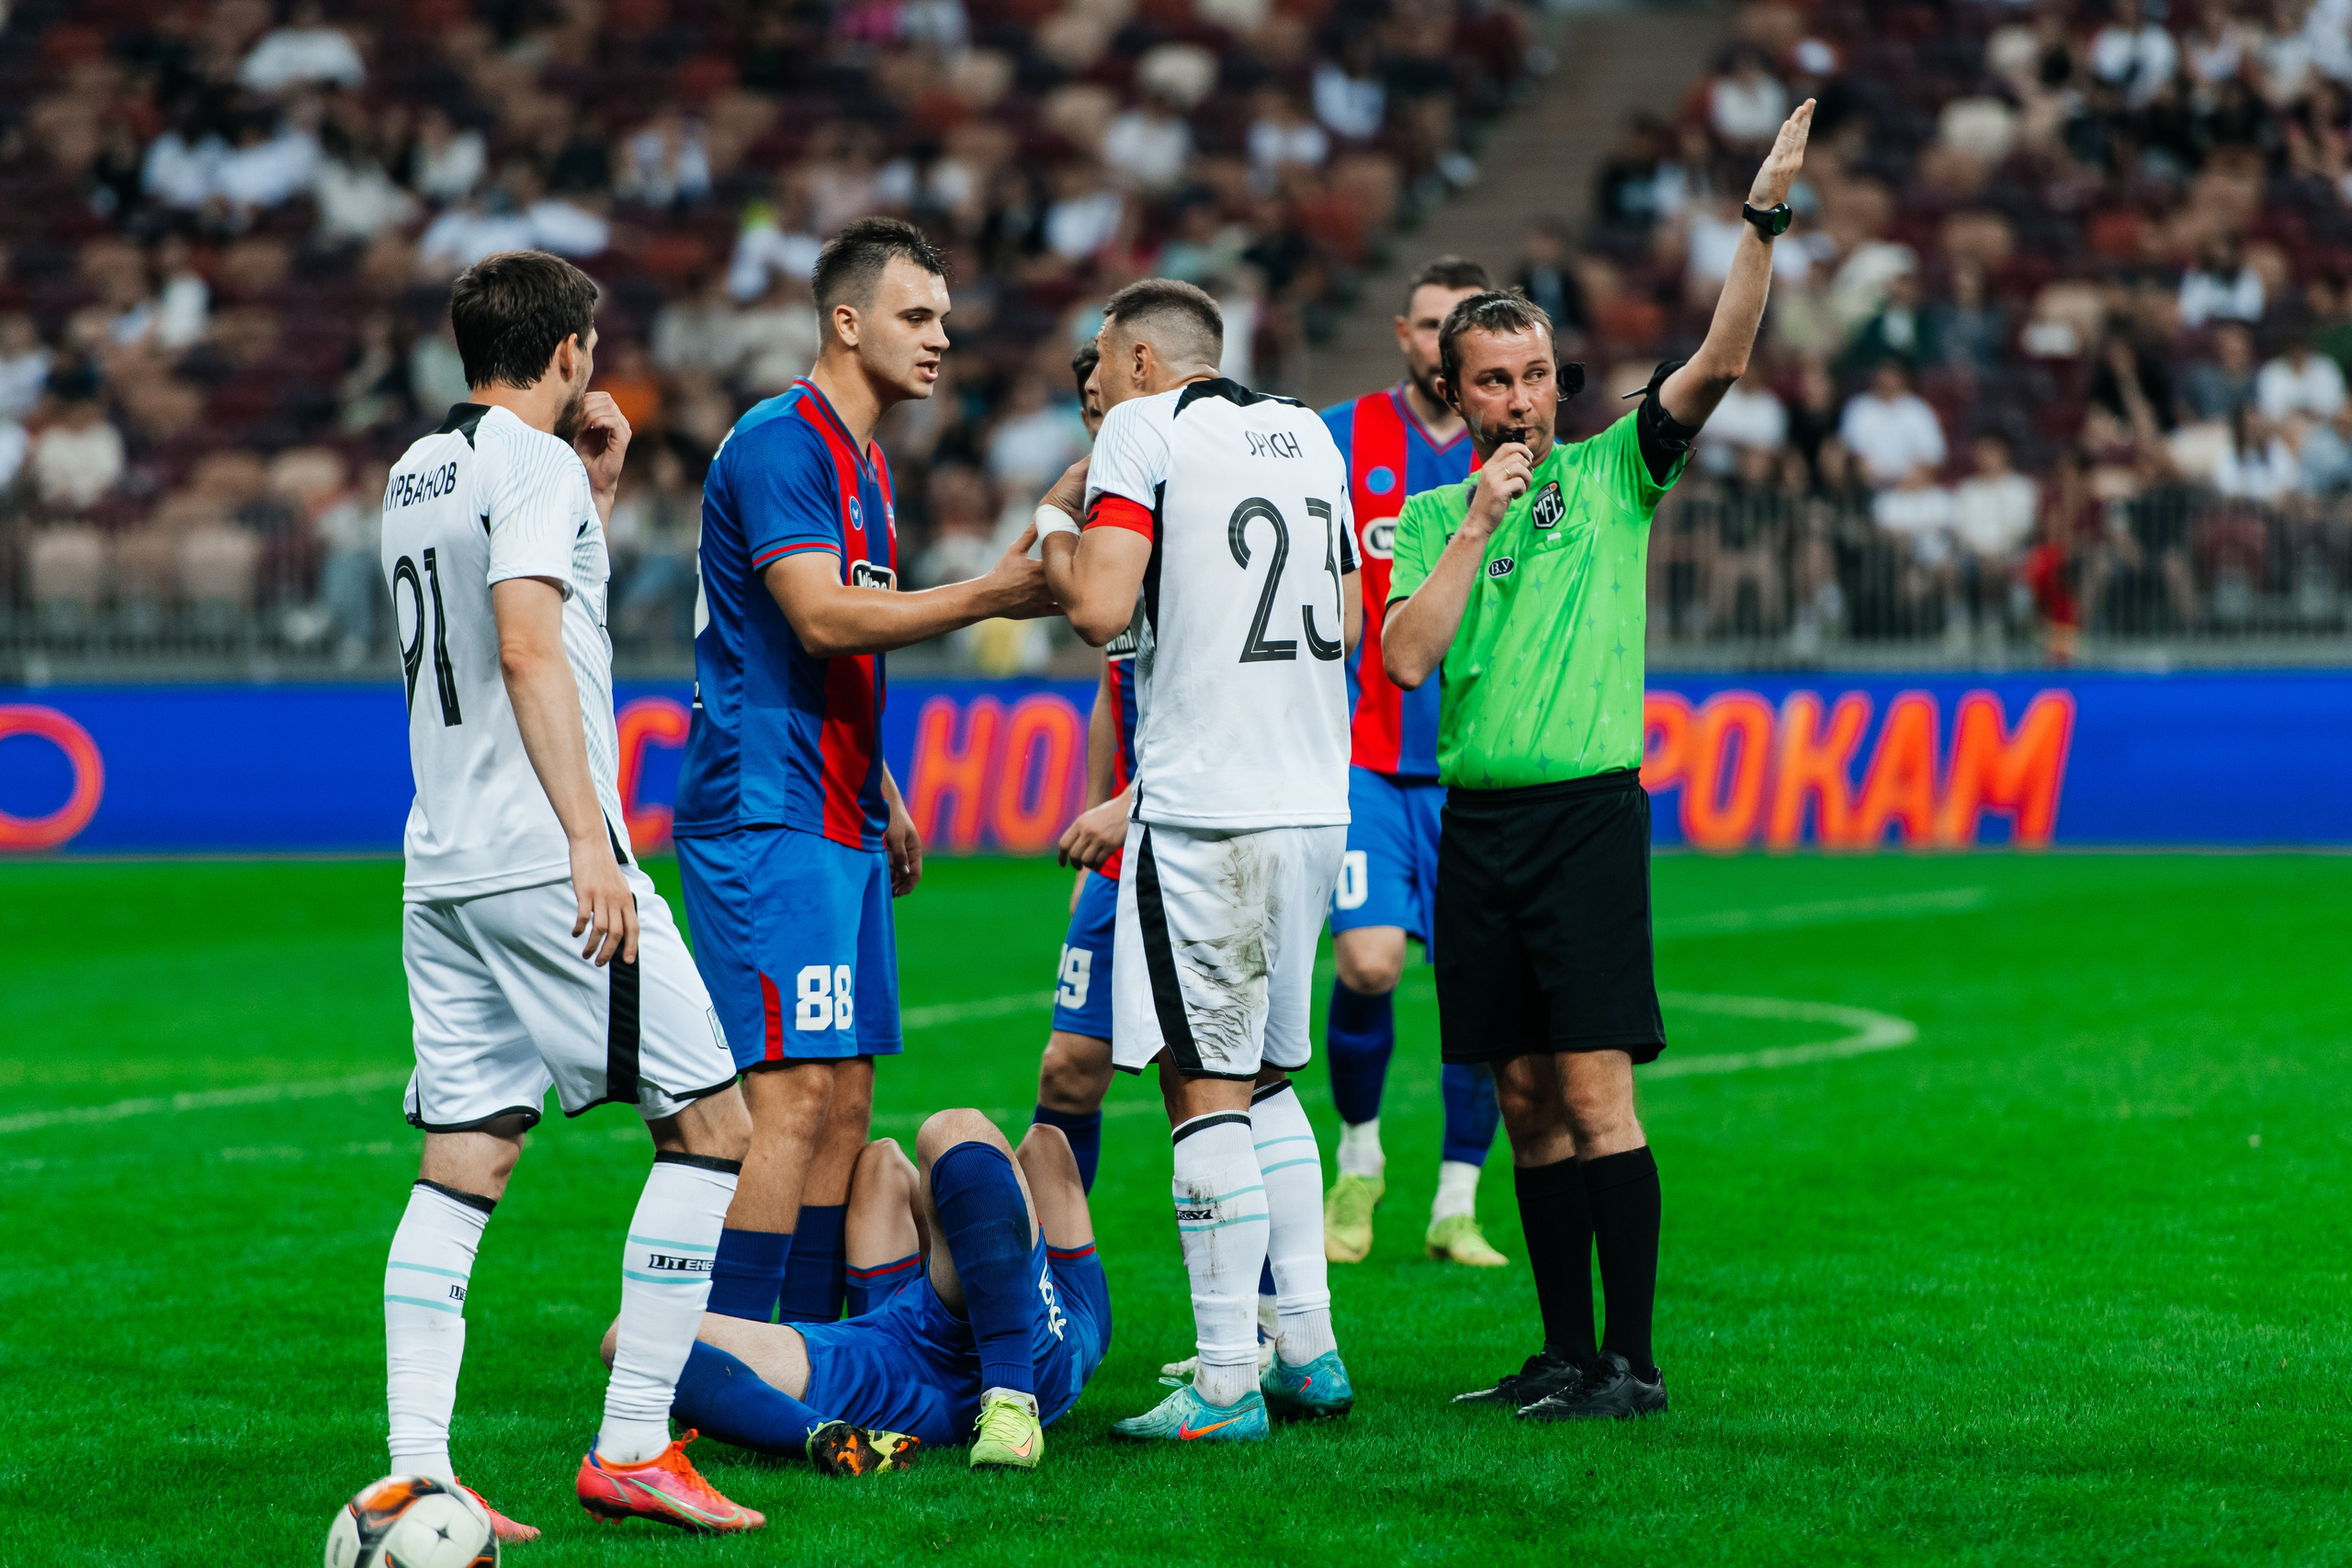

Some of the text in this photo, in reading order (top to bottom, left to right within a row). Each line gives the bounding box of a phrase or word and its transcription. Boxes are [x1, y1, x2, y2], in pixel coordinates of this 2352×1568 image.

[1245, 430, 1303, 458] SPICH
[393, 547, 463, 728] 91
[1227, 497, 1343, 663] 23
[796, 964, 854, 1031] 88
